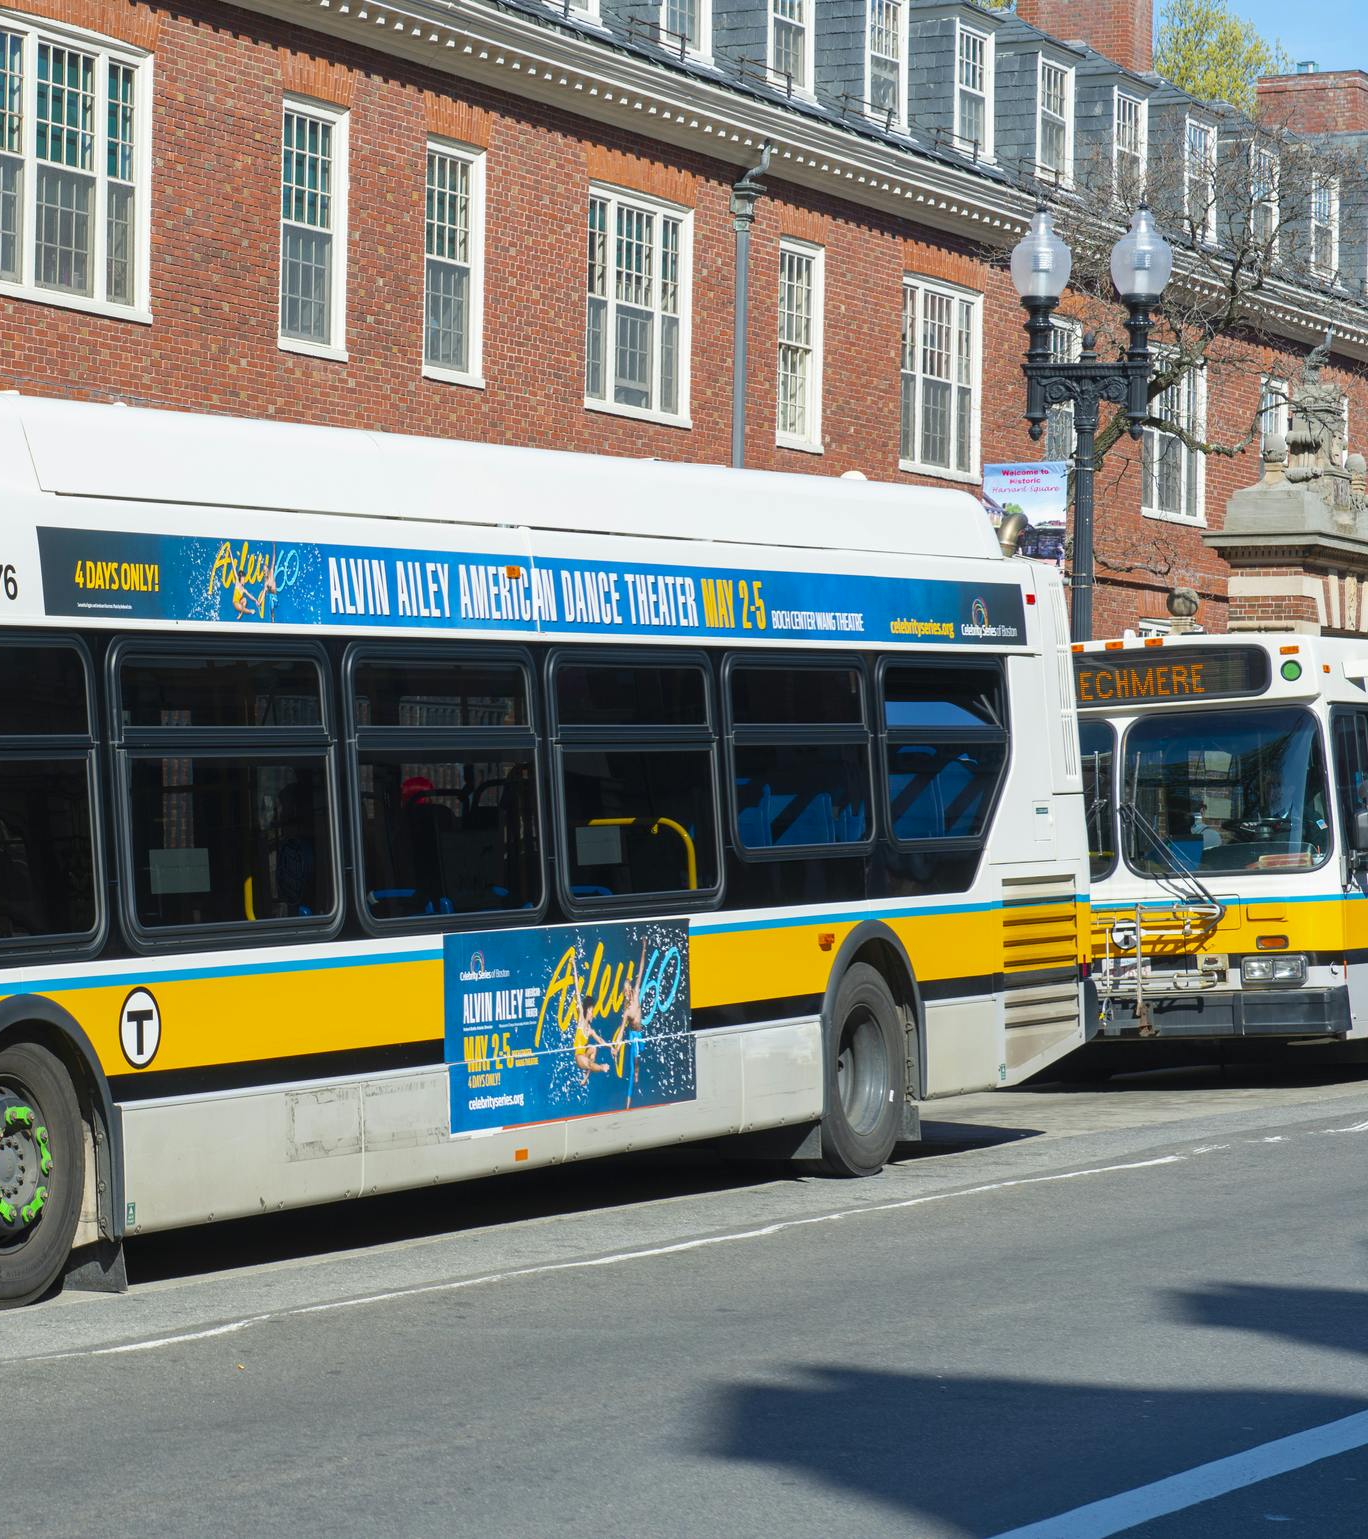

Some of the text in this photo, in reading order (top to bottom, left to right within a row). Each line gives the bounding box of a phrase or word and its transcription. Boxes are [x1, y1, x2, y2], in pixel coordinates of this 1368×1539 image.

[1001, 468, 1038, 477] Welcome
[74, 560, 160, 592] 4 DAYS ONLY!
[328, 557, 767, 630] ALVIN AILEY AMERICAN DANCE THEATER MAY 2-5
[771, 610, 865, 632] BOCH CENTER WANG THEATRE
[890, 618, 955, 639] celebrityseries.org
[961, 624, 982, 638] Celebrity
[982, 624, 996, 637] Series
[1079, 663, 1205, 701] ECHMERE
[463, 988, 523, 1024] ALVIN AILEY
[127, 1009, 153, 1055] T
[464, 1032, 514, 1072] MAY 2-5
[469, 1093, 524, 1110] celebrityseries.org
